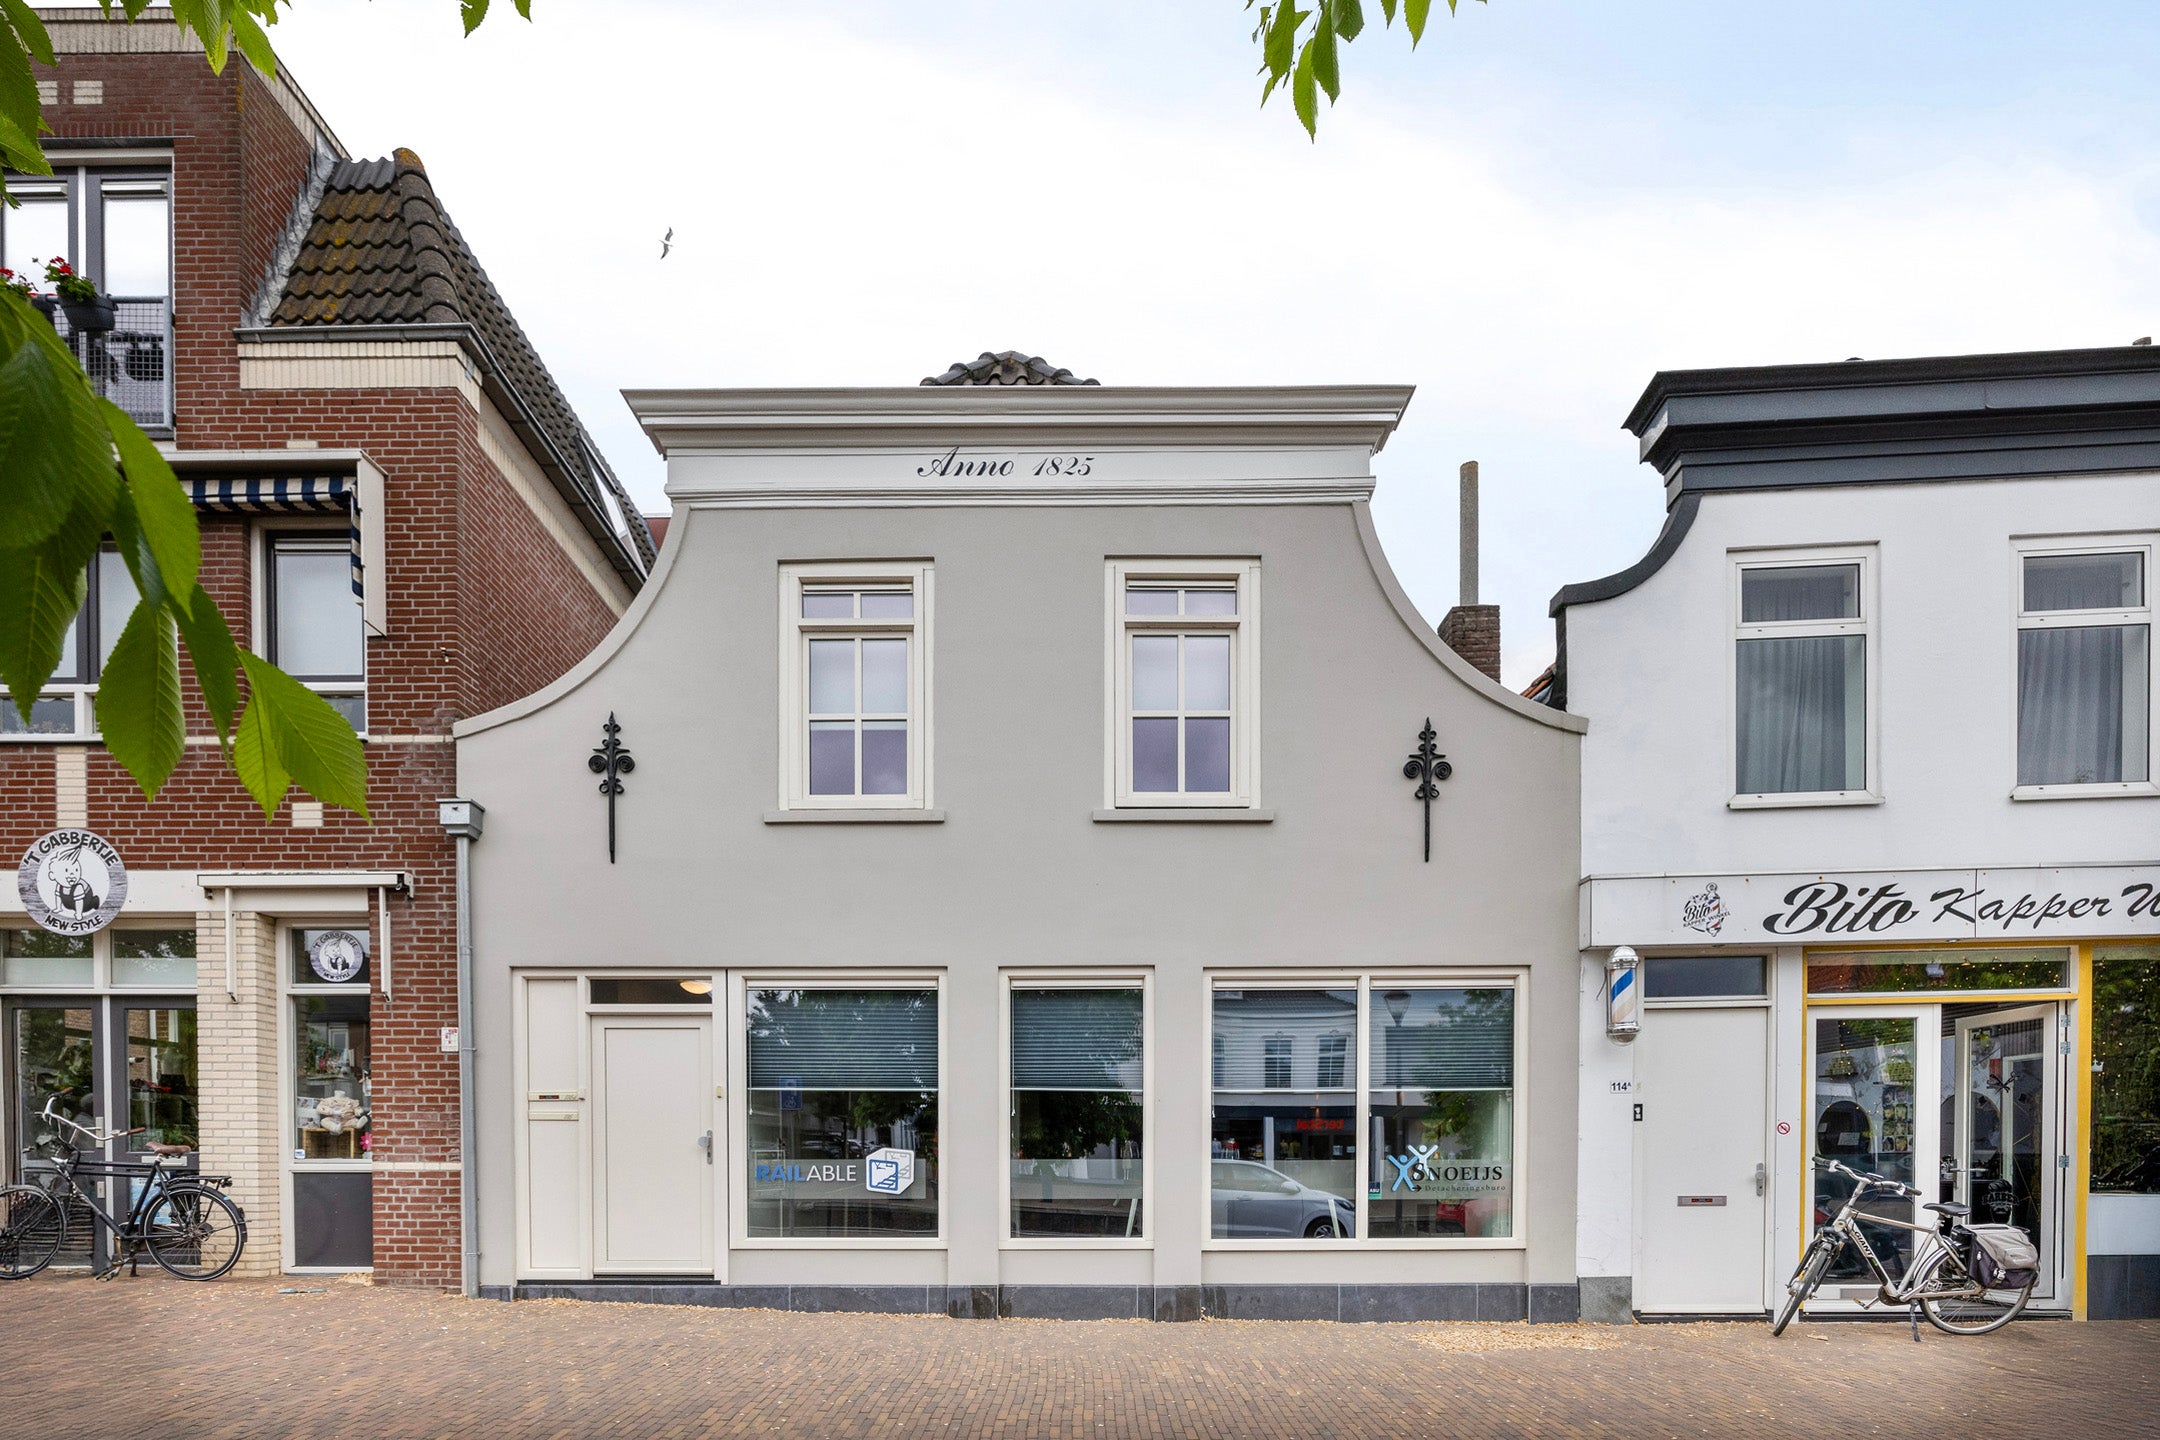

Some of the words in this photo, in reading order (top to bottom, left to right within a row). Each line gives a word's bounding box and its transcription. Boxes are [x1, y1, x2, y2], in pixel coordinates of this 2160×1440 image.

[917, 446, 1015, 477] Anno
[1032, 456, 1095, 476] 1825
[38, 831, 119, 867] GABBERTJE
[1762, 881, 1919, 934] Bito
[1929, 887, 2112, 929] Kapper
[44, 914, 69, 931] NEW
[70, 915, 104, 932] STYLE
[755, 1165, 857, 1182] RAILABLE
[1410, 1162, 1503, 1182] SNOEIJS
[1854, 1231, 1874, 1257] GIANT
